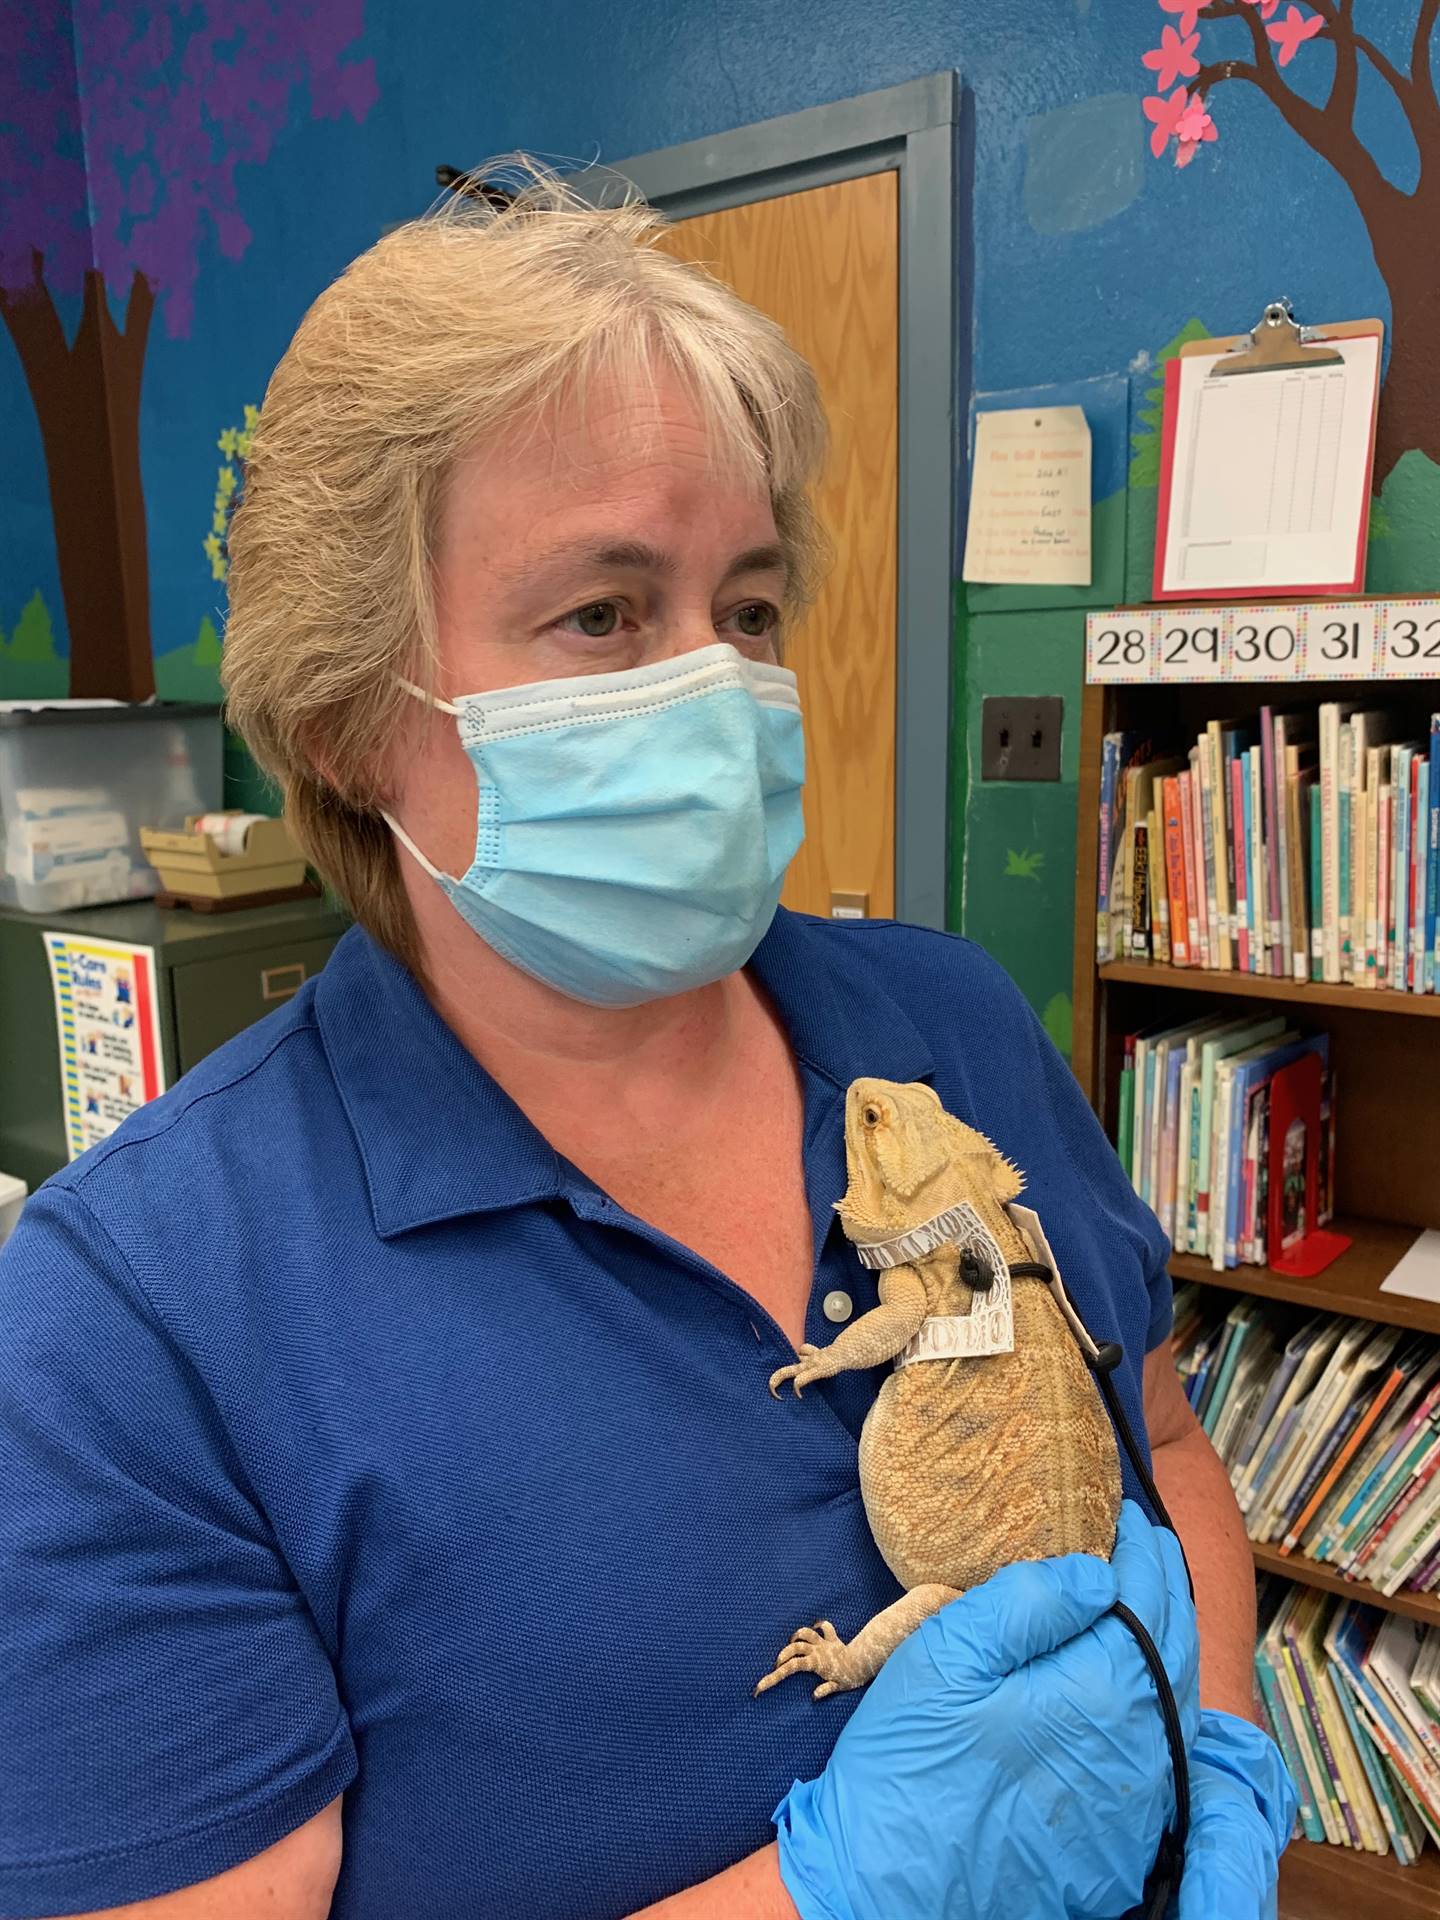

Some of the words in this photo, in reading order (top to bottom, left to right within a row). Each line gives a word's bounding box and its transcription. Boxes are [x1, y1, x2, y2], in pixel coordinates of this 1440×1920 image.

[1097, 629, 1146, 665] 28
[1164, 626, 1219, 663] 29
[1234, 624, 1296, 662] 30
[1320, 621, 1360, 660] 31
[1390, 618, 1440, 659] 32
[72, 971, 102, 991] Rules
